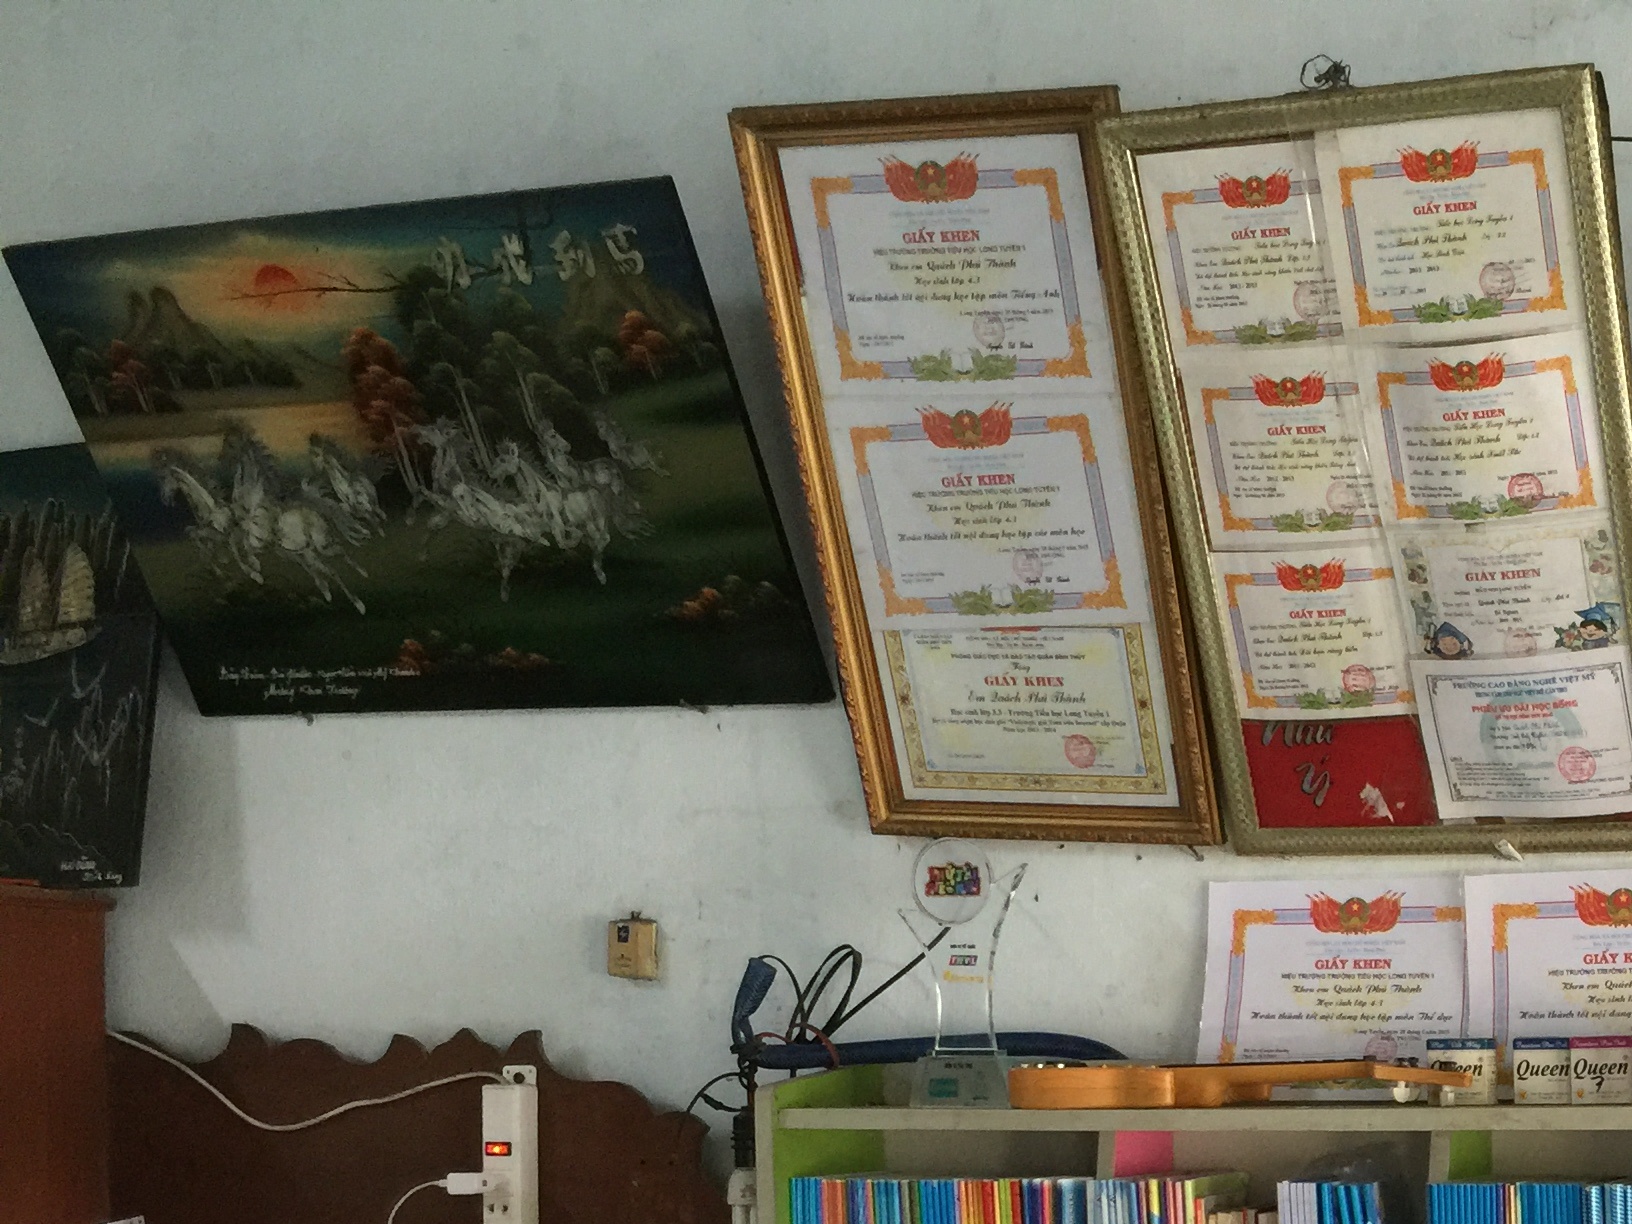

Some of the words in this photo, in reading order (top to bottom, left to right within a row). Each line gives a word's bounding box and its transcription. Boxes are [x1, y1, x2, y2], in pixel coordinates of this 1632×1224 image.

[1445, 201, 1477, 212] KHEN
[941, 230, 980, 243] KHEN
[977, 474, 1015, 485] KHEN
[1314, 955, 1348, 970] GIẤY
[1353, 959, 1392, 969] KHEN
[1583, 949, 1619, 965] GIẤY
[1517, 1059, 1571, 1080] Queen
[1573, 1058, 1628, 1079] Queen
